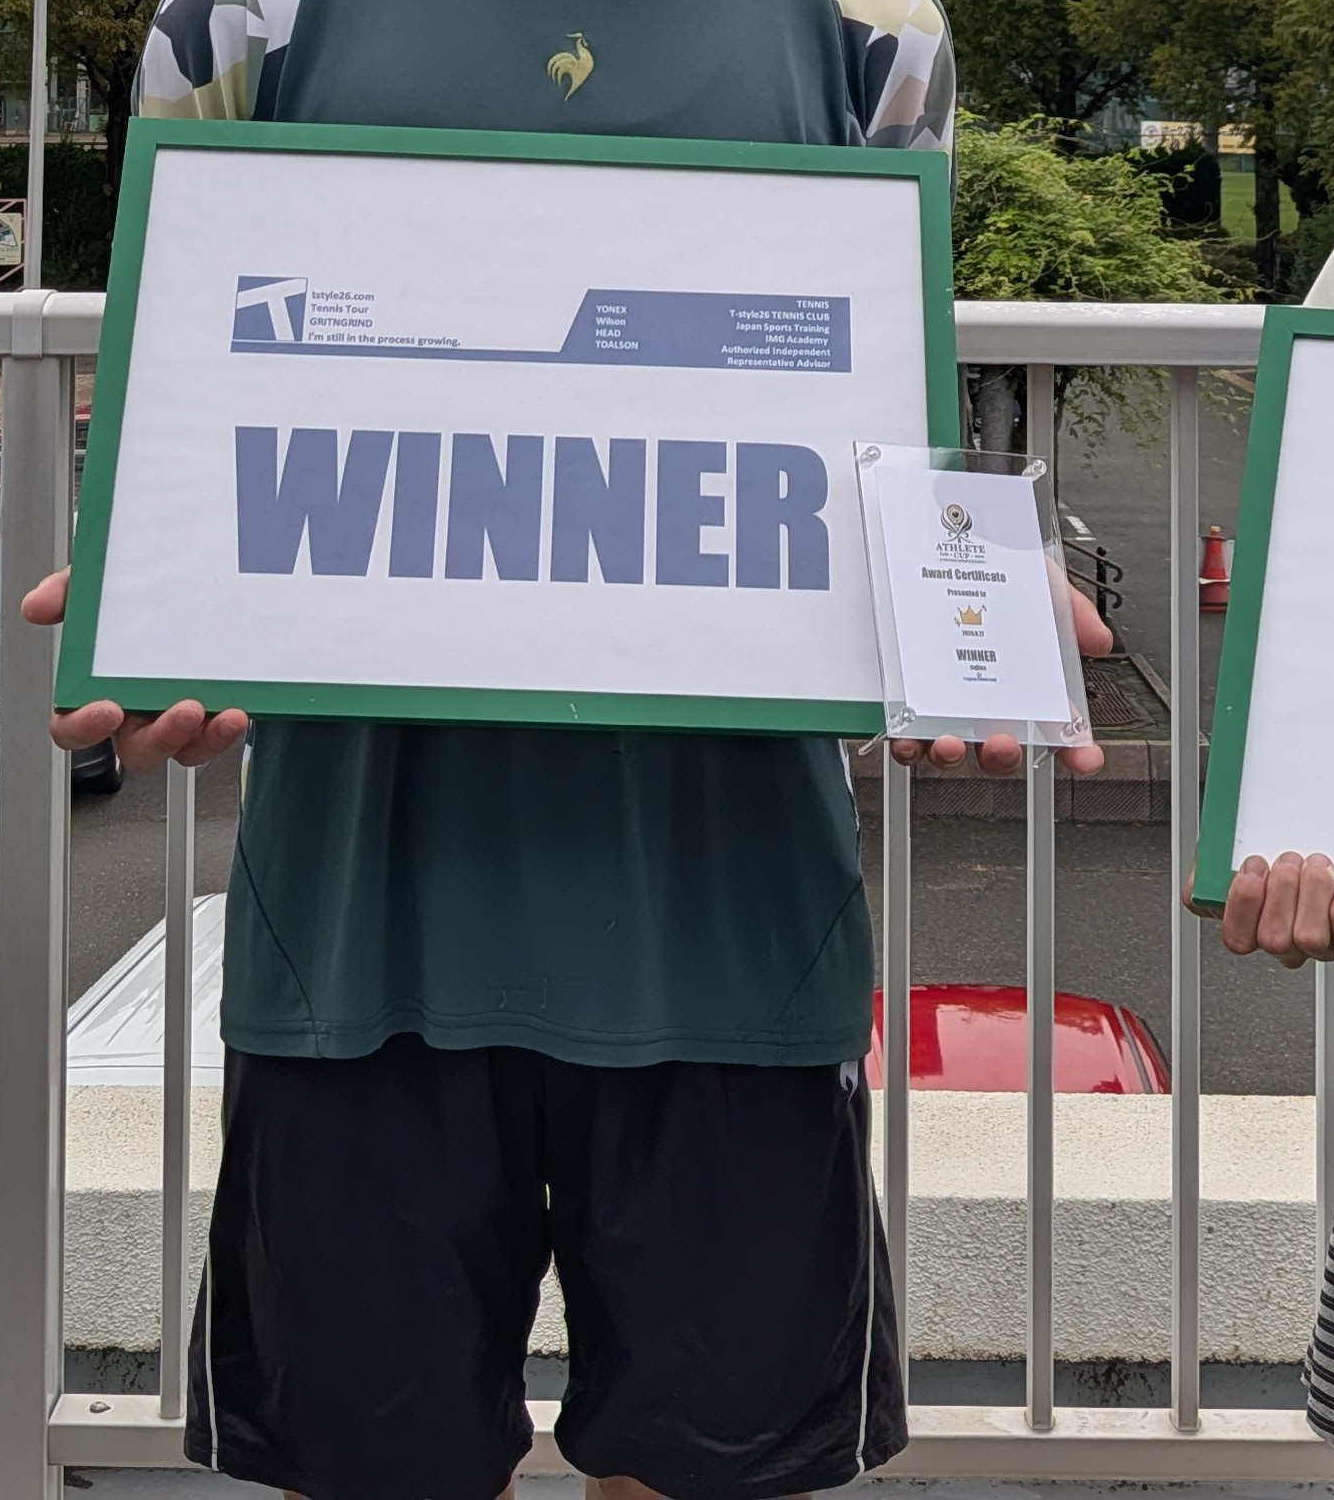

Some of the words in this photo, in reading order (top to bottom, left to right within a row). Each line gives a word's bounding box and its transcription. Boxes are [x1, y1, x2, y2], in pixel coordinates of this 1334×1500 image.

[311, 291, 375, 301] tstyle26.com
[311, 303, 343, 313] Tennis
[345, 305, 369, 314] Tour
[596, 305, 627, 315] YONEX
[797, 300, 830, 310] TENNIS
[729, 309, 771, 320] T-style26
[771, 311, 805, 320] TENNIS
[806, 312, 830, 321] CLUB
[309, 317, 373, 328] GRITNGRIND
[596, 317, 626, 326] Wilson
[596, 328, 621, 338] HEAD
[735, 322, 763, 331] Japan
[763, 323, 793, 332] Sports
[794, 324, 830, 335] Training
[308, 331, 324, 341] I'm
[326, 333, 345, 343] still
[347, 333, 356, 343] in
[358, 333, 375, 343] the
[377, 335, 416, 348] process
[417, 336, 461, 347] growing.
[595, 340, 639, 350] TOALSON
[765, 335, 786, 343] IMG
[786, 336, 829, 346] Academy
[721, 345, 771, 355] Authorized
[772, 347, 831, 357] Independent
[727, 357, 795, 367] Representative
[796, 359, 831, 368] Advisor
[234, 425, 831, 592] WINNER
[936, 542, 986, 554] ATHLETE
[921, 566, 954, 580] Award
[954, 568, 1007, 583] Certificate
[947, 588, 979, 597] Presented
[979, 590, 987, 598] to
[956, 648, 997, 663] WINNER
